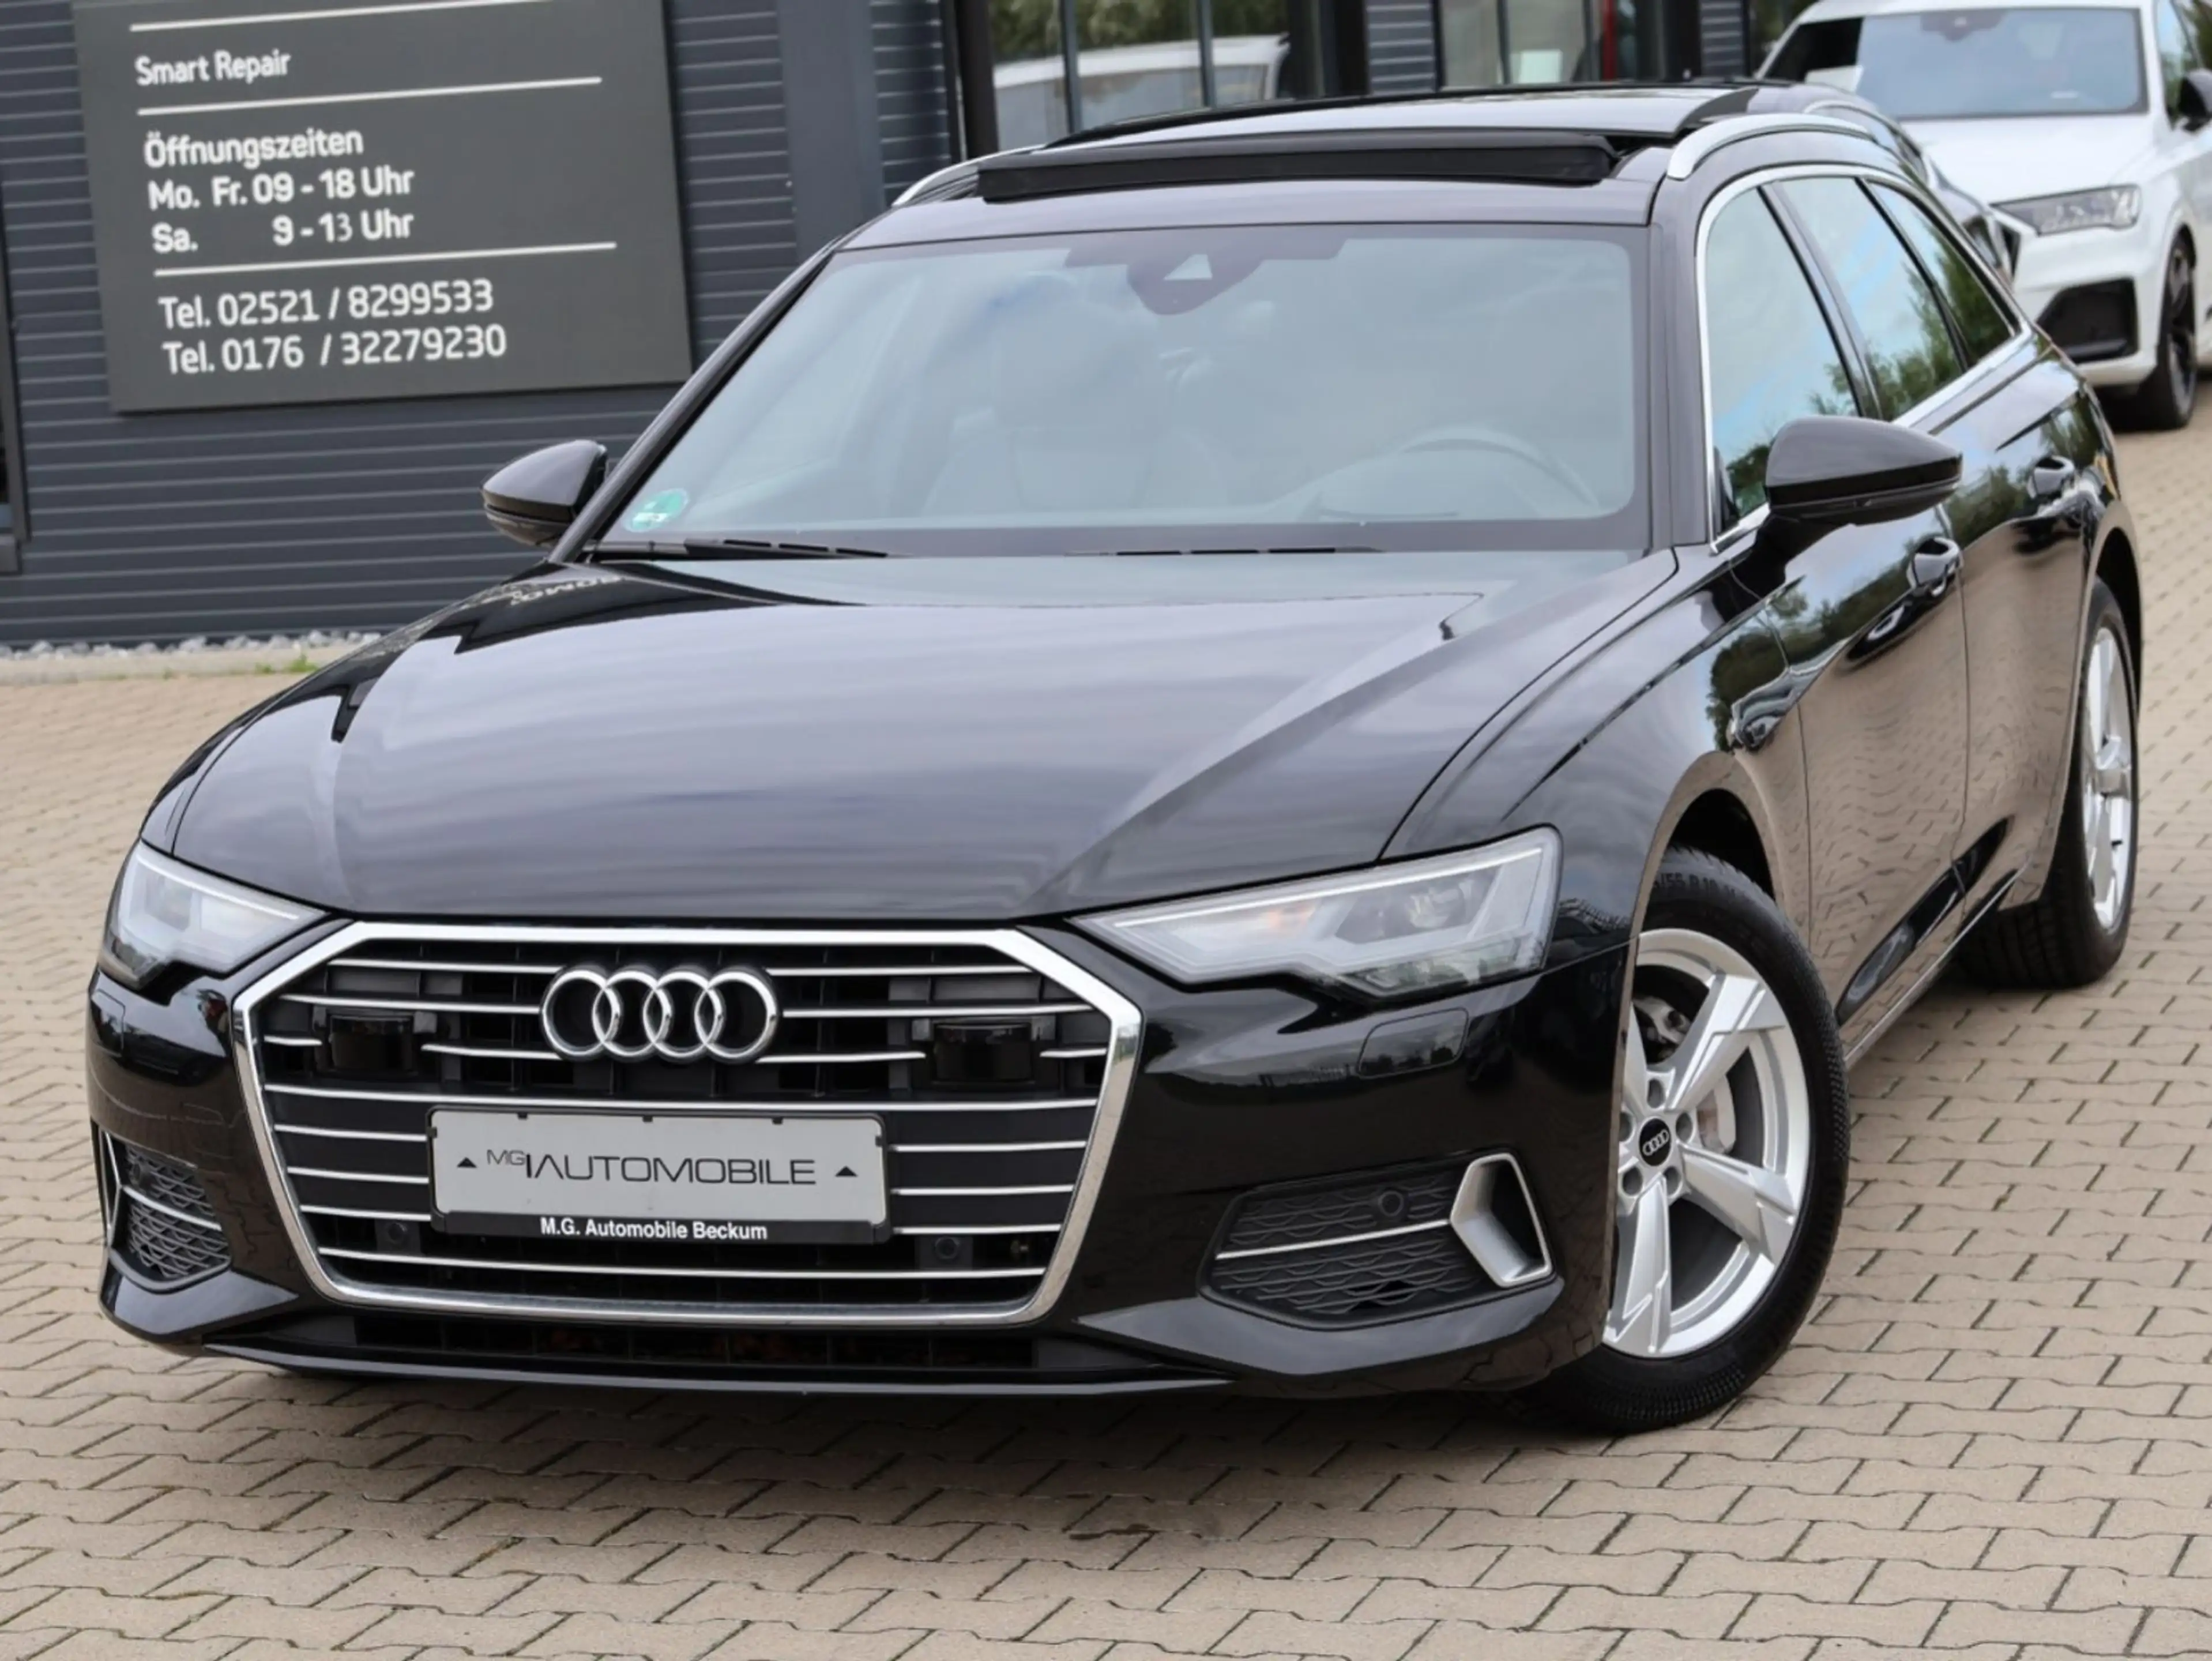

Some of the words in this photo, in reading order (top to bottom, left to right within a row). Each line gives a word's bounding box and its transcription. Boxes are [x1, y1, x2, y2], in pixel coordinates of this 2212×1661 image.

[134, 55, 210, 86] Smart
[213, 48, 291, 84] Repair
[144, 127, 364, 170] Öffnungszeiten
[148, 179, 201, 211] Mo.
[211, 175, 248, 206] Fr.
[251, 172, 295, 204] 09
[318, 168, 356, 199] 18
[360, 164, 415, 197] Uhr
[151, 221, 199, 254] Sa.
[272, 215, 295, 246] 9
[318, 212, 353, 243] 13
[360, 208, 415, 240] Uhr
[157, 295, 212, 329] Tel.
[217, 289, 320, 326] 02521
[347, 278, 494, 319] 8299533
[161, 340, 216, 374] Tel.
[221, 336, 304, 371] 0176
[340, 323, 507, 365] 32279230
[540, 1216, 581, 1236] M.G.
[585, 1218, 689, 1239] Automobile
[693, 1220, 768, 1240] Beckum
